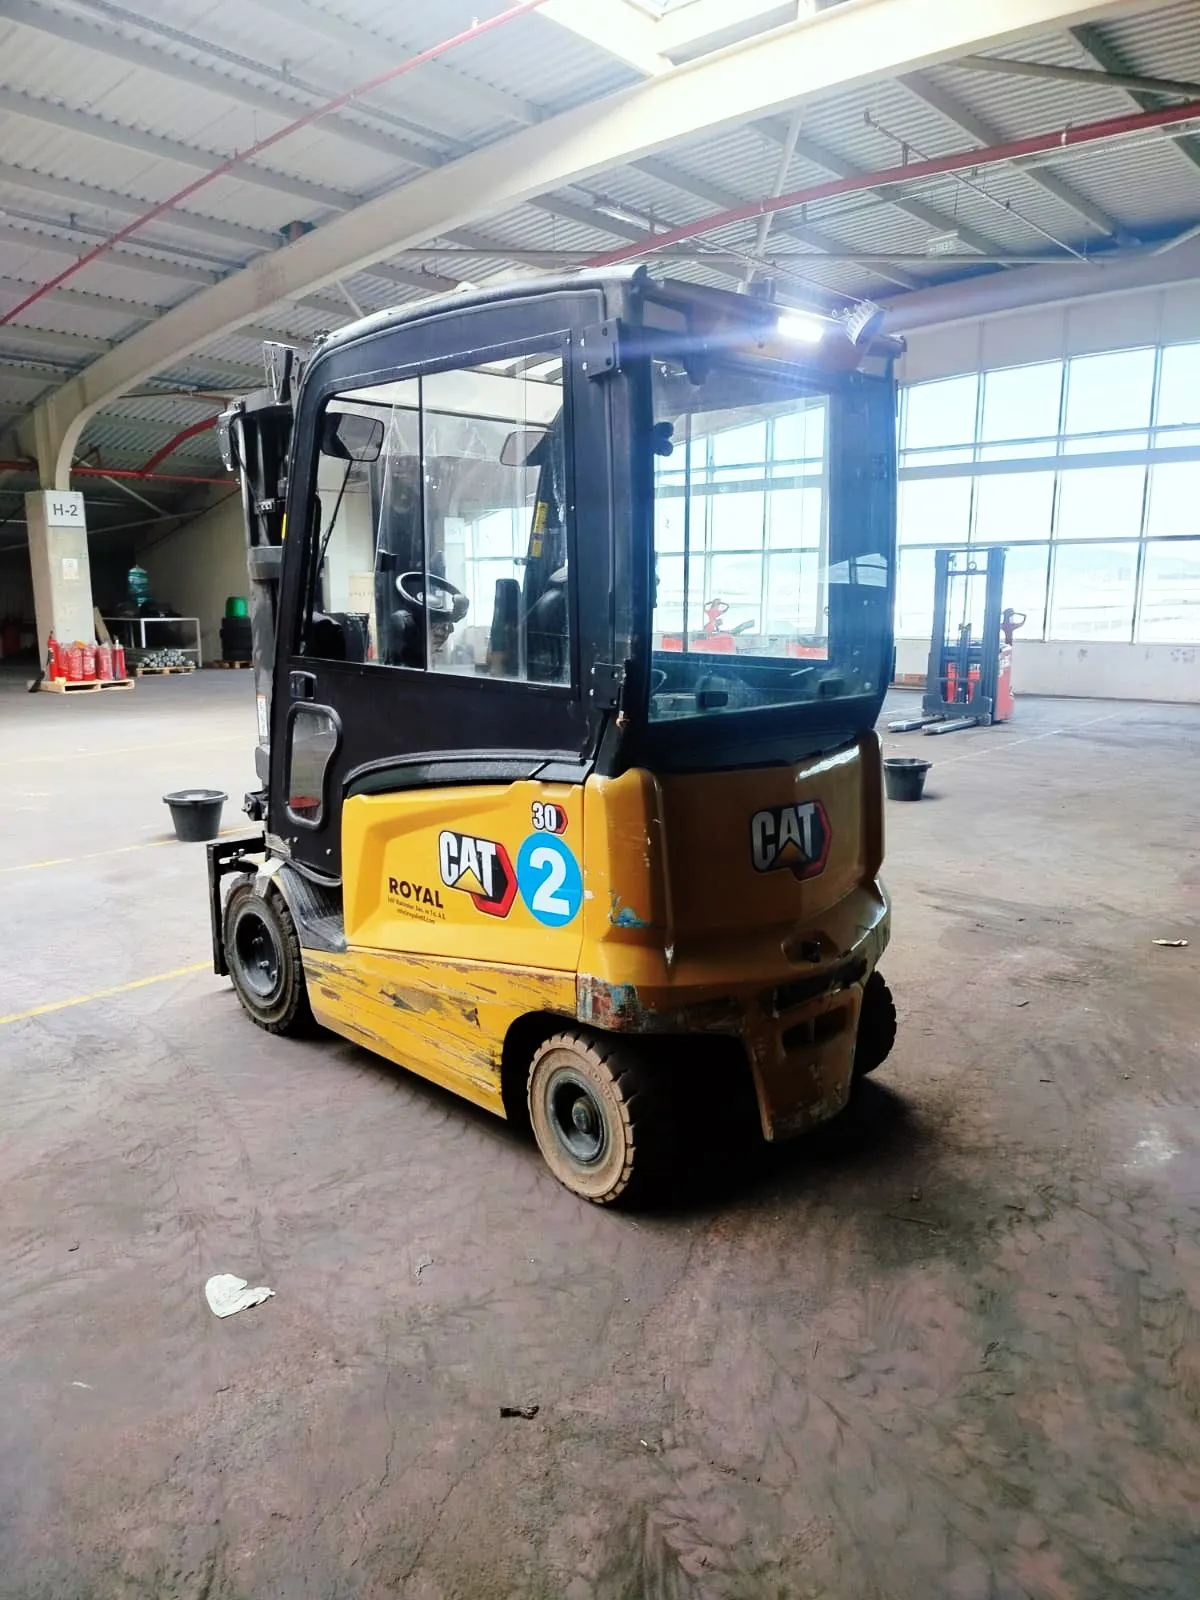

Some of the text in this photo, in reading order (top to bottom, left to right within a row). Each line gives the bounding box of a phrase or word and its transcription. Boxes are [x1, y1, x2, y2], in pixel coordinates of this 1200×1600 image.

[53, 503, 78, 517] H-2
[532, 801, 557, 832] 30
[752, 802, 815, 870] CAT
[439, 831, 497, 898] CAT
[529, 846, 570, 917] 2
[388, 876, 444, 909] ROYAL
